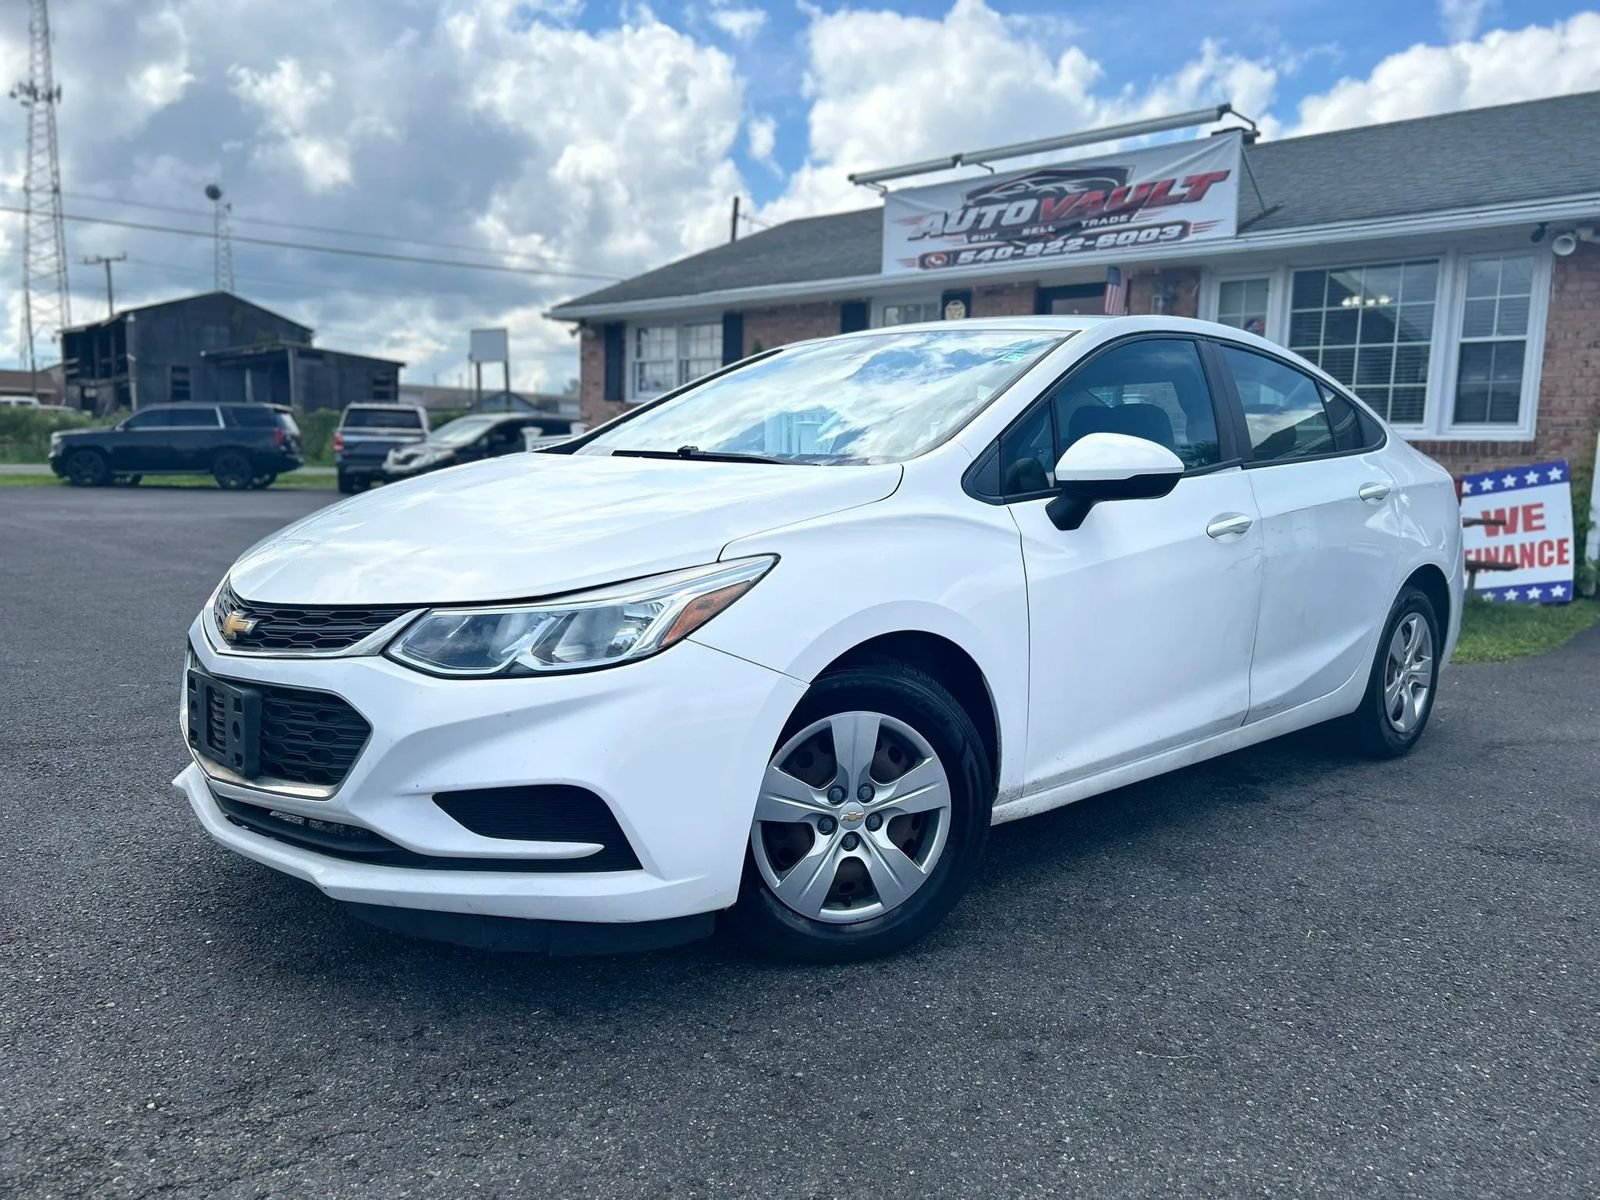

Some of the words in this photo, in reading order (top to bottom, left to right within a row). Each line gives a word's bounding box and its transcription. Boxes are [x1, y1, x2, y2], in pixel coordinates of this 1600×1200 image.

[957, 224, 1184, 264] 540-922-6003
[970, 232, 998, 242] BUY
[1080, 214, 1129, 228] TRADE
[1481, 503, 1546, 537] WE
[1464, 538, 1569, 575] FINANCE
